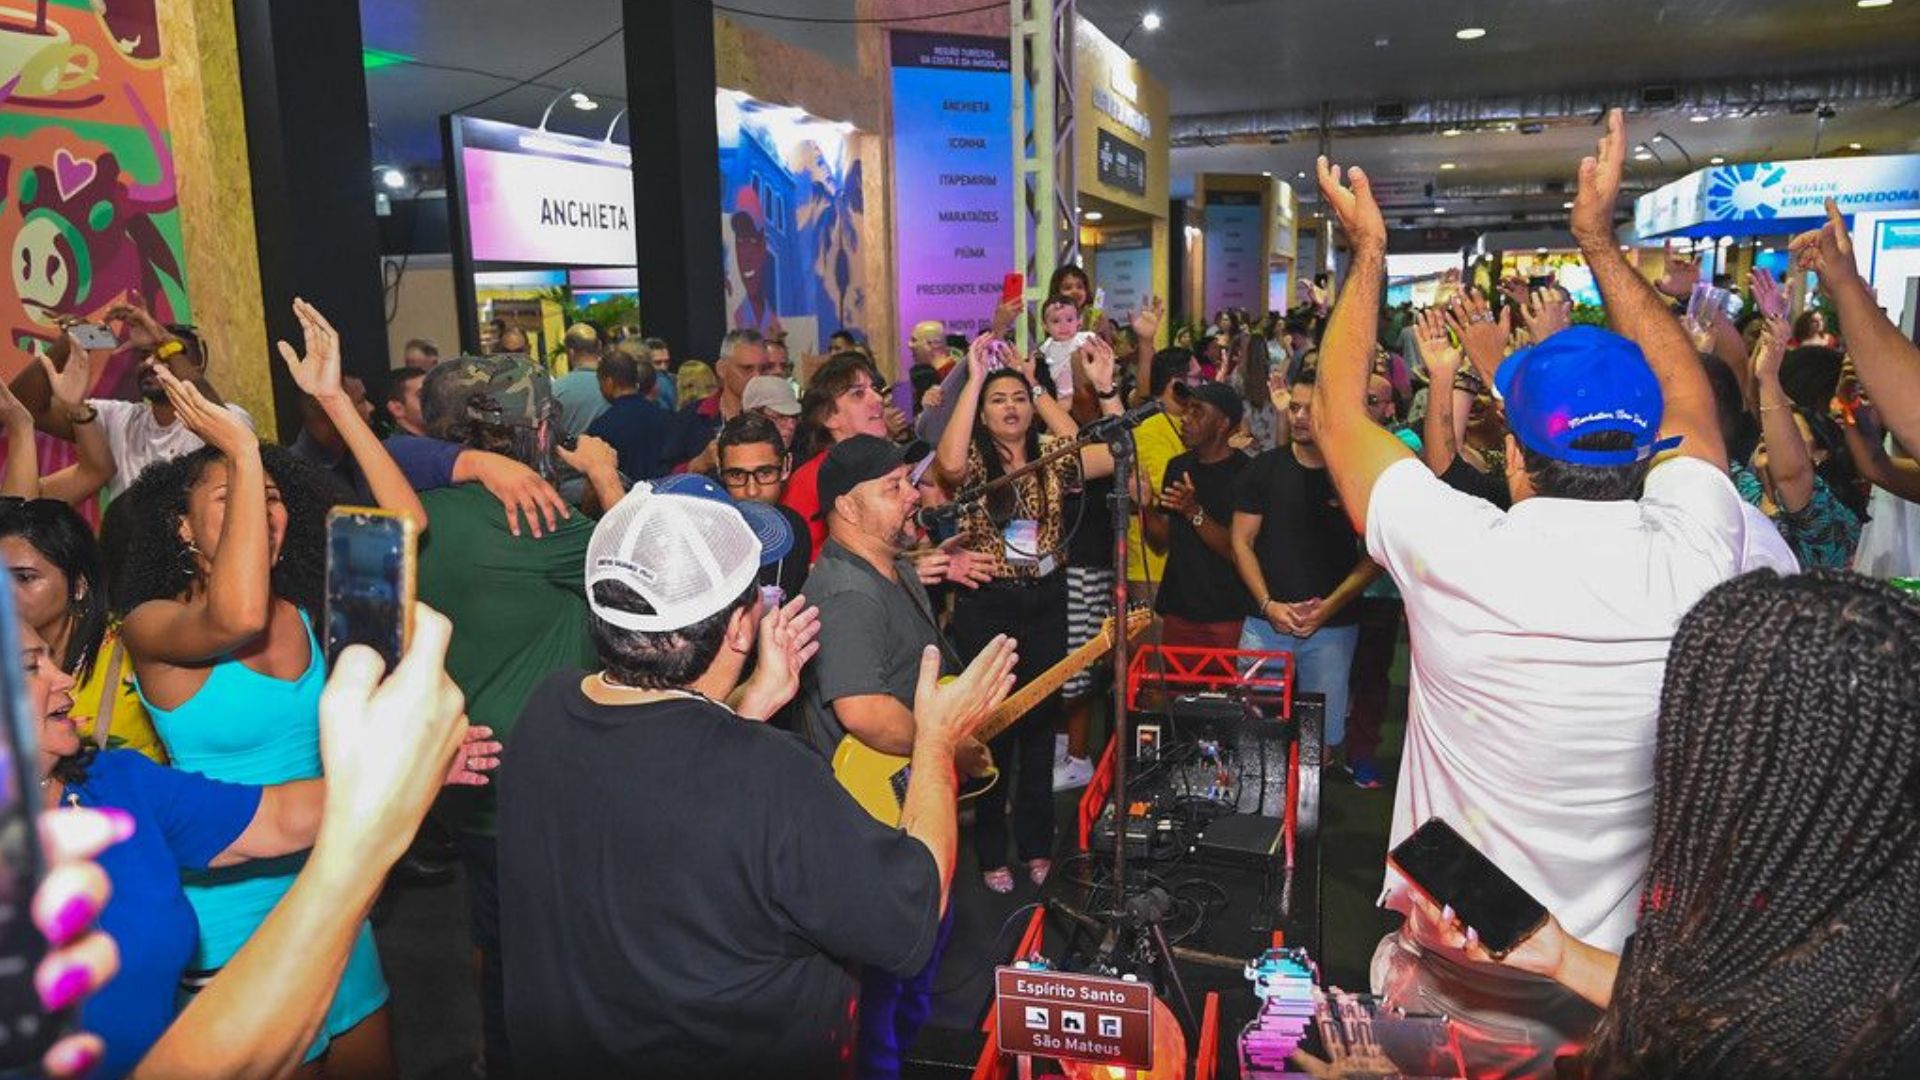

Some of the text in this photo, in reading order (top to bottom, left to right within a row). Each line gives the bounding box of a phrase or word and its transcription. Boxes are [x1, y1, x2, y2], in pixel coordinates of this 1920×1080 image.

[943, 100, 990, 112] ANCHIETA
[949, 138, 986, 149] ICONHA
[939, 175, 997, 187] ITAPEMIRIM
[541, 198, 629, 231] ANCHIETA
[939, 210, 999, 223] MARATAÍZES
[955, 245, 985, 258] PIÚMA
[916, 284, 977, 295] PRESIDENTE
[1017, 979, 1126, 1004] Espírito Santo
[1032, 1034, 1121, 1056] São Mateus
